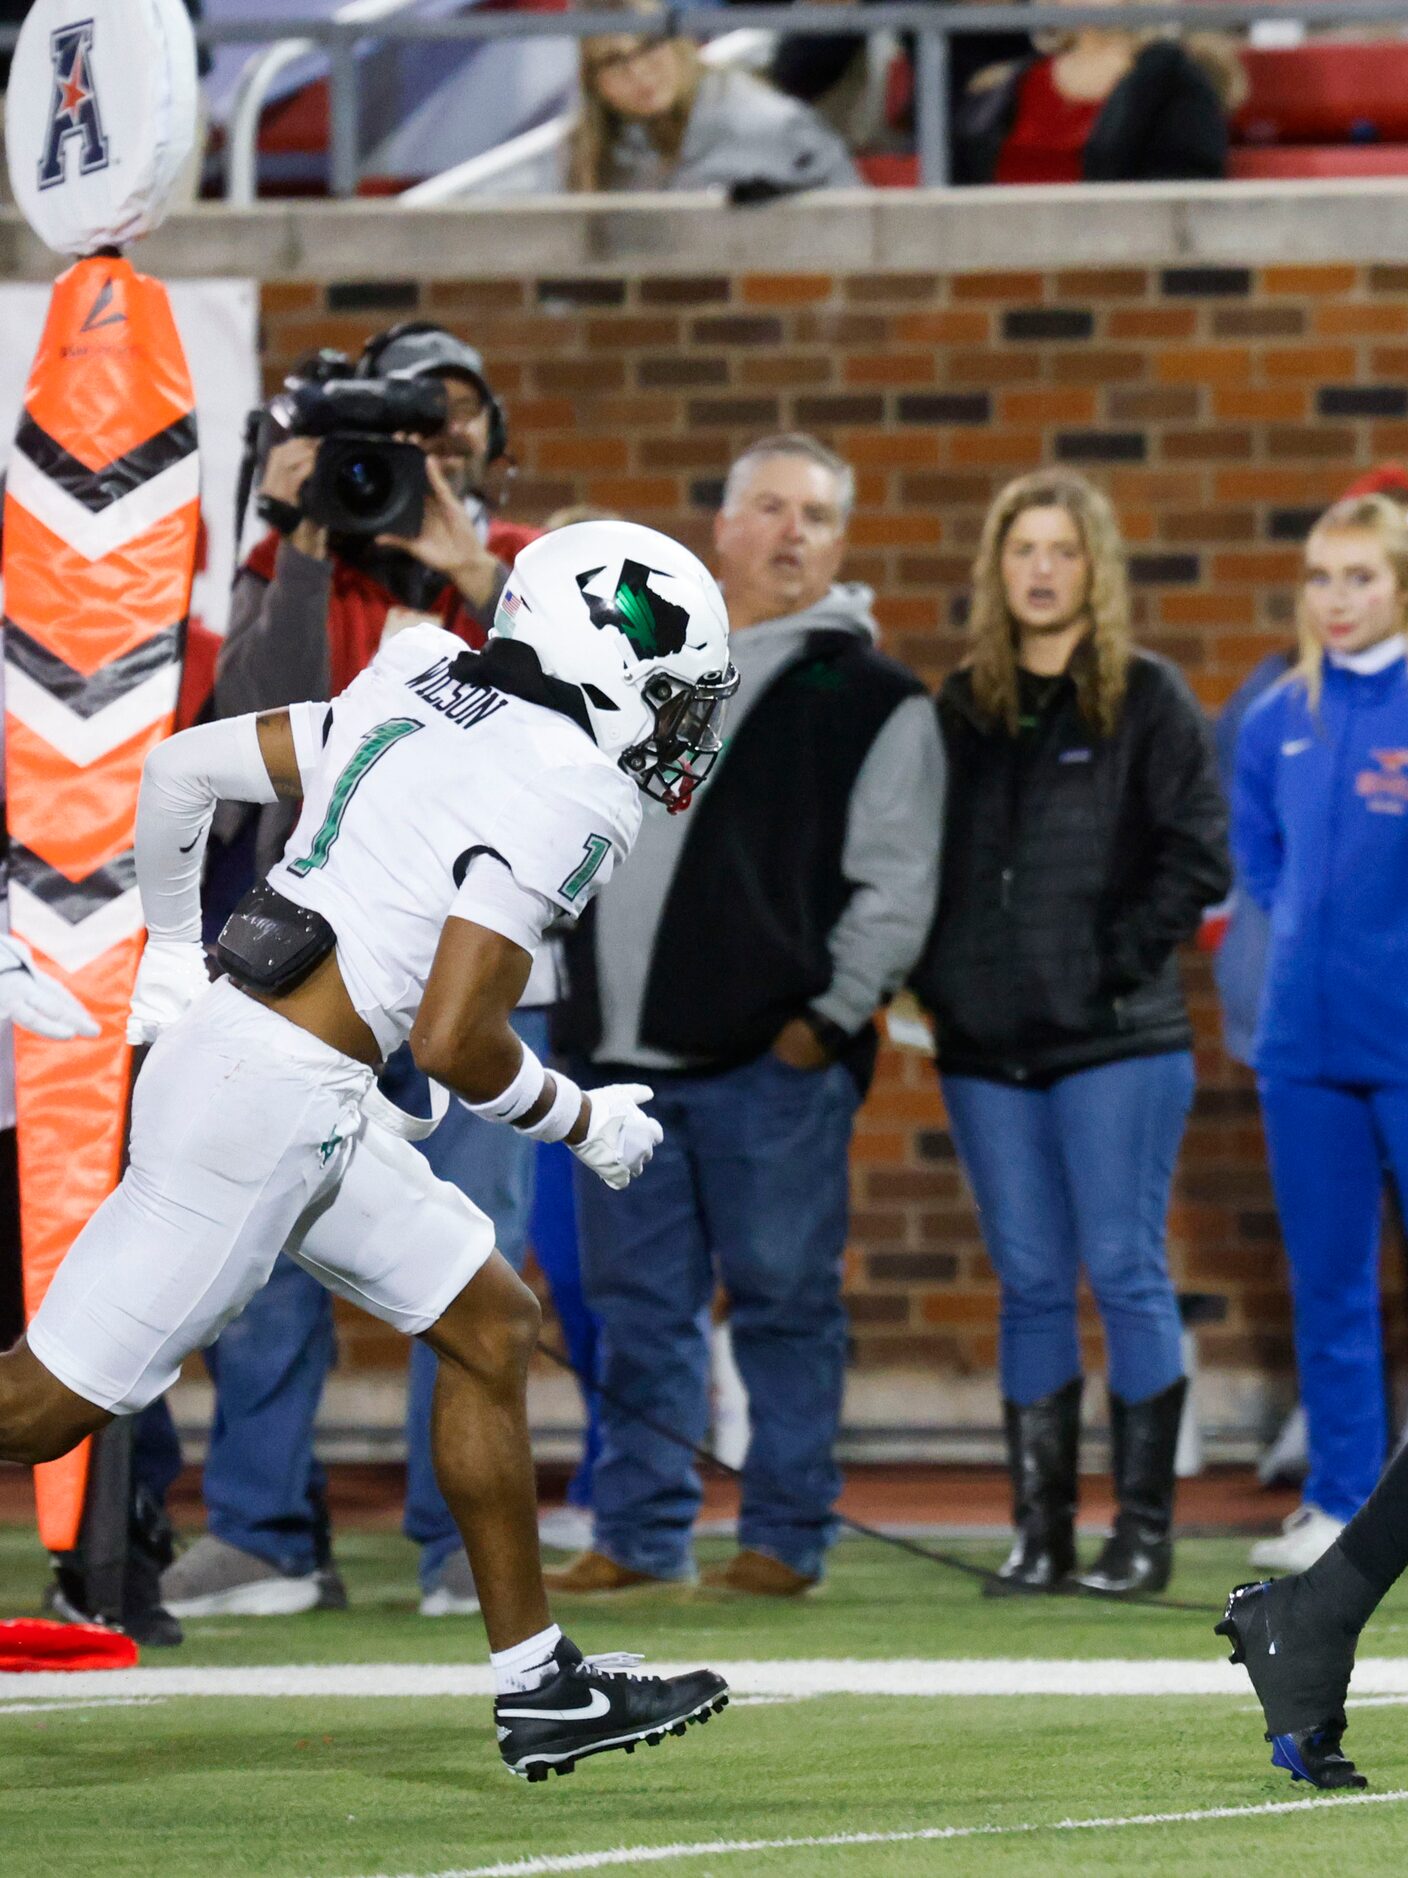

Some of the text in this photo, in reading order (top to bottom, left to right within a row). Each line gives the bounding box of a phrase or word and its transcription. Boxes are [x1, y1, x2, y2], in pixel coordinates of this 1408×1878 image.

[38, 18, 109, 191] A
[404, 656, 509, 729] WILSON
[287, 717, 426, 878] 1
[558, 833, 612, 901] 1
